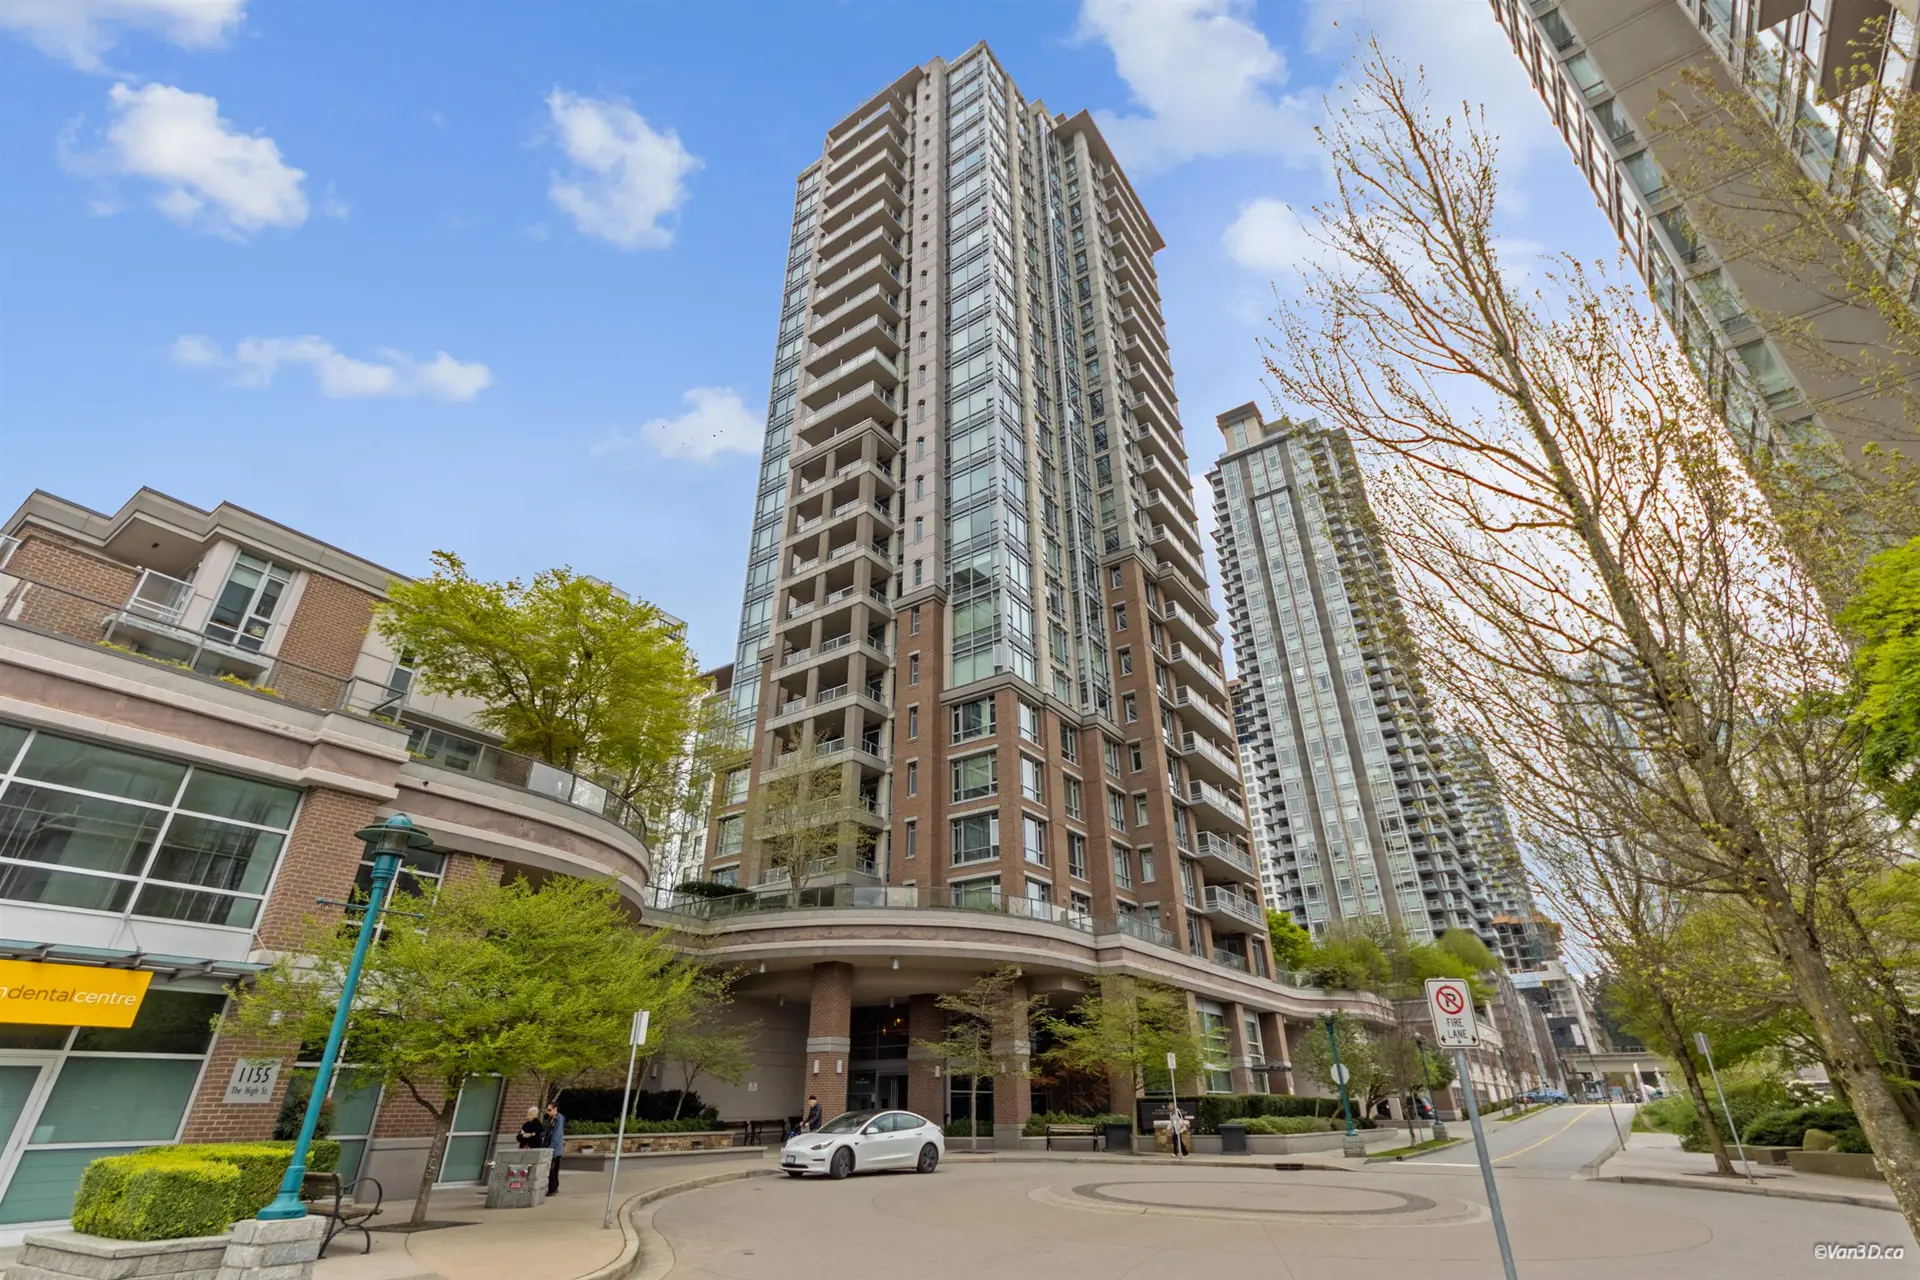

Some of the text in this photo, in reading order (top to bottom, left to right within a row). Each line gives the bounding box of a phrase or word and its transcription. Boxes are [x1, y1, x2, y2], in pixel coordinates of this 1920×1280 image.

[1446, 1018, 1464, 1027] FIRE
[1447, 1030, 1468, 1039] LANE
[239, 1067, 271, 1083] 1155
[231, 1086, 242, 1094] The
[244, 1086, 259, 1097] High
